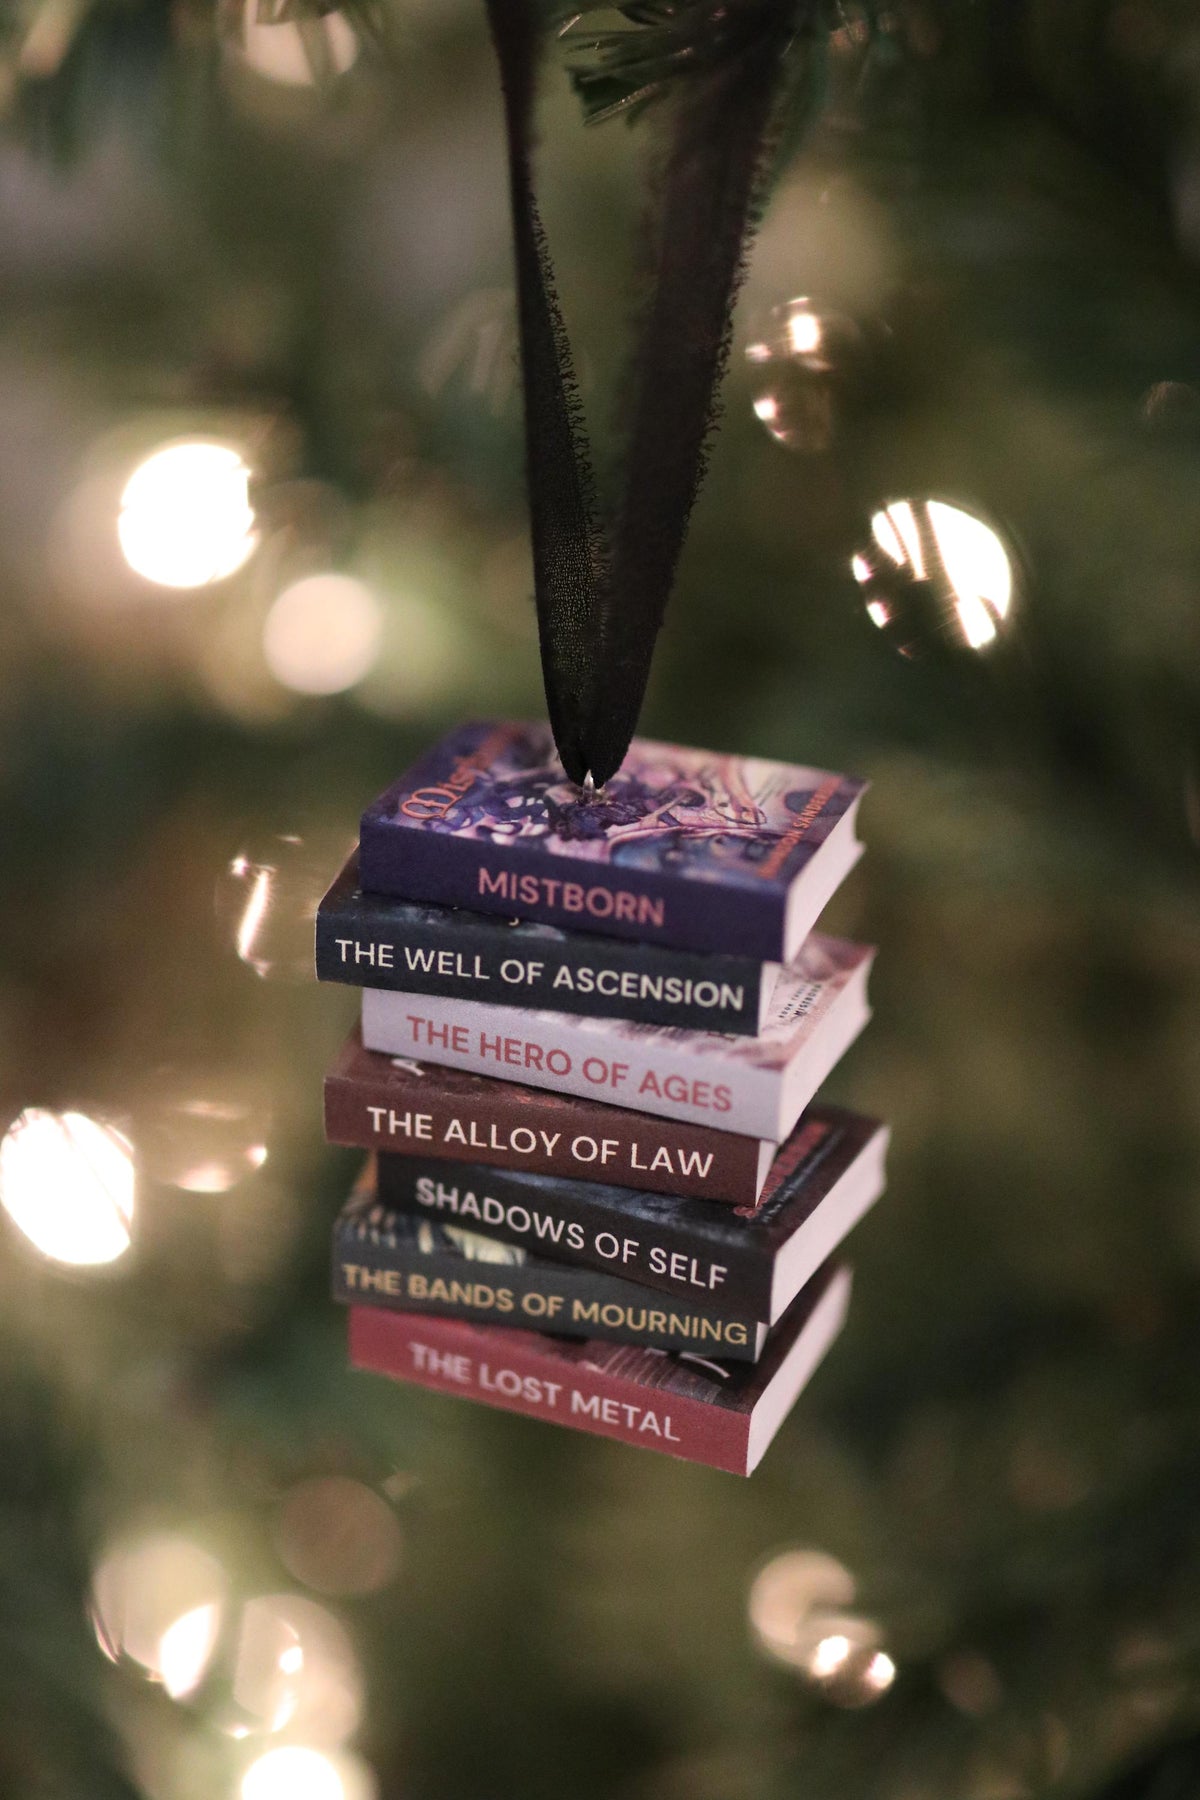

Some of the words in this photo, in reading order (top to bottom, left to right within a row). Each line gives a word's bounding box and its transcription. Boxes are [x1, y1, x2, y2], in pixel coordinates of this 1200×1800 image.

[478, 867, 665, 927] MISTBORN
[335, 939, 394, 968] THE
[404, 947, 490, 980] WELL
[500, 958, 544, 985] OF
[553, 965, 743, 1011] ASCENSION
[407, 1015, 469, 1053] THE
[480, 1032, 572, 1076] HERO
[582, 1057, 628, 1088] OF
[638, 1075, 733, 1112] AGES
[367, 1106, 432, 1140] THE
[444, 1119, 561, 1157] ALLOY
[571, 1135, 617, 1164] OF
[631, 1143, 714, 1178] LAW
[416, 1177, 585, 1250] SHADOWS
[595, 1232, 639, 1264] OF
[649, 1247, 728, 1290] SELF
[342, 1263, 402, 1296] THE
[408, 1273, 513, 1312] BANDS
[521, 1292, 564, 1317] OF
[572, 1300, 747, 1345] MOURNING
[410, 1341, 471, 1383] THE
[479, 1363, 562, 1408] LOST
[570, 1390, 681, 1442] METAL
